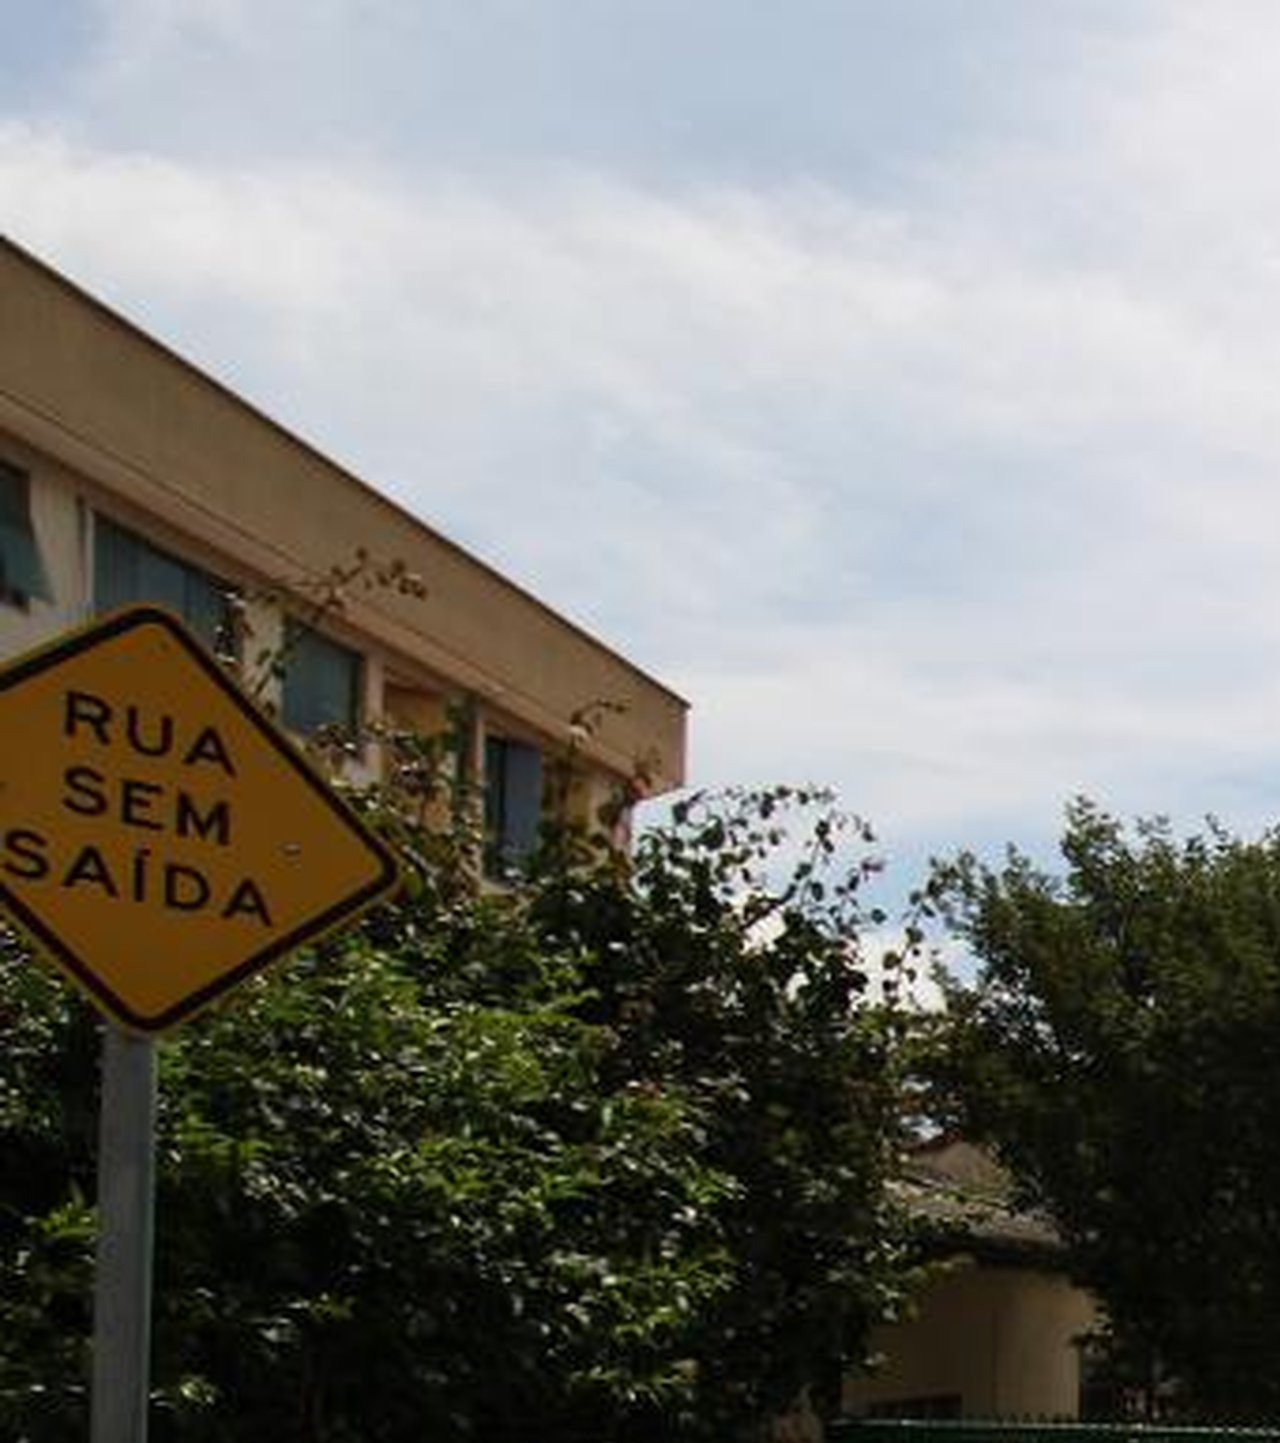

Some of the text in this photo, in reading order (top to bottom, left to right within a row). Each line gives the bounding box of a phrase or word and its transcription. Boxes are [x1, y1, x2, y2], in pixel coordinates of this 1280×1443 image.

[63, 692, 236, 778] RUA
[62, 767, 230, 846] SEM
[3, 829, 272, 927] SAÍDA
